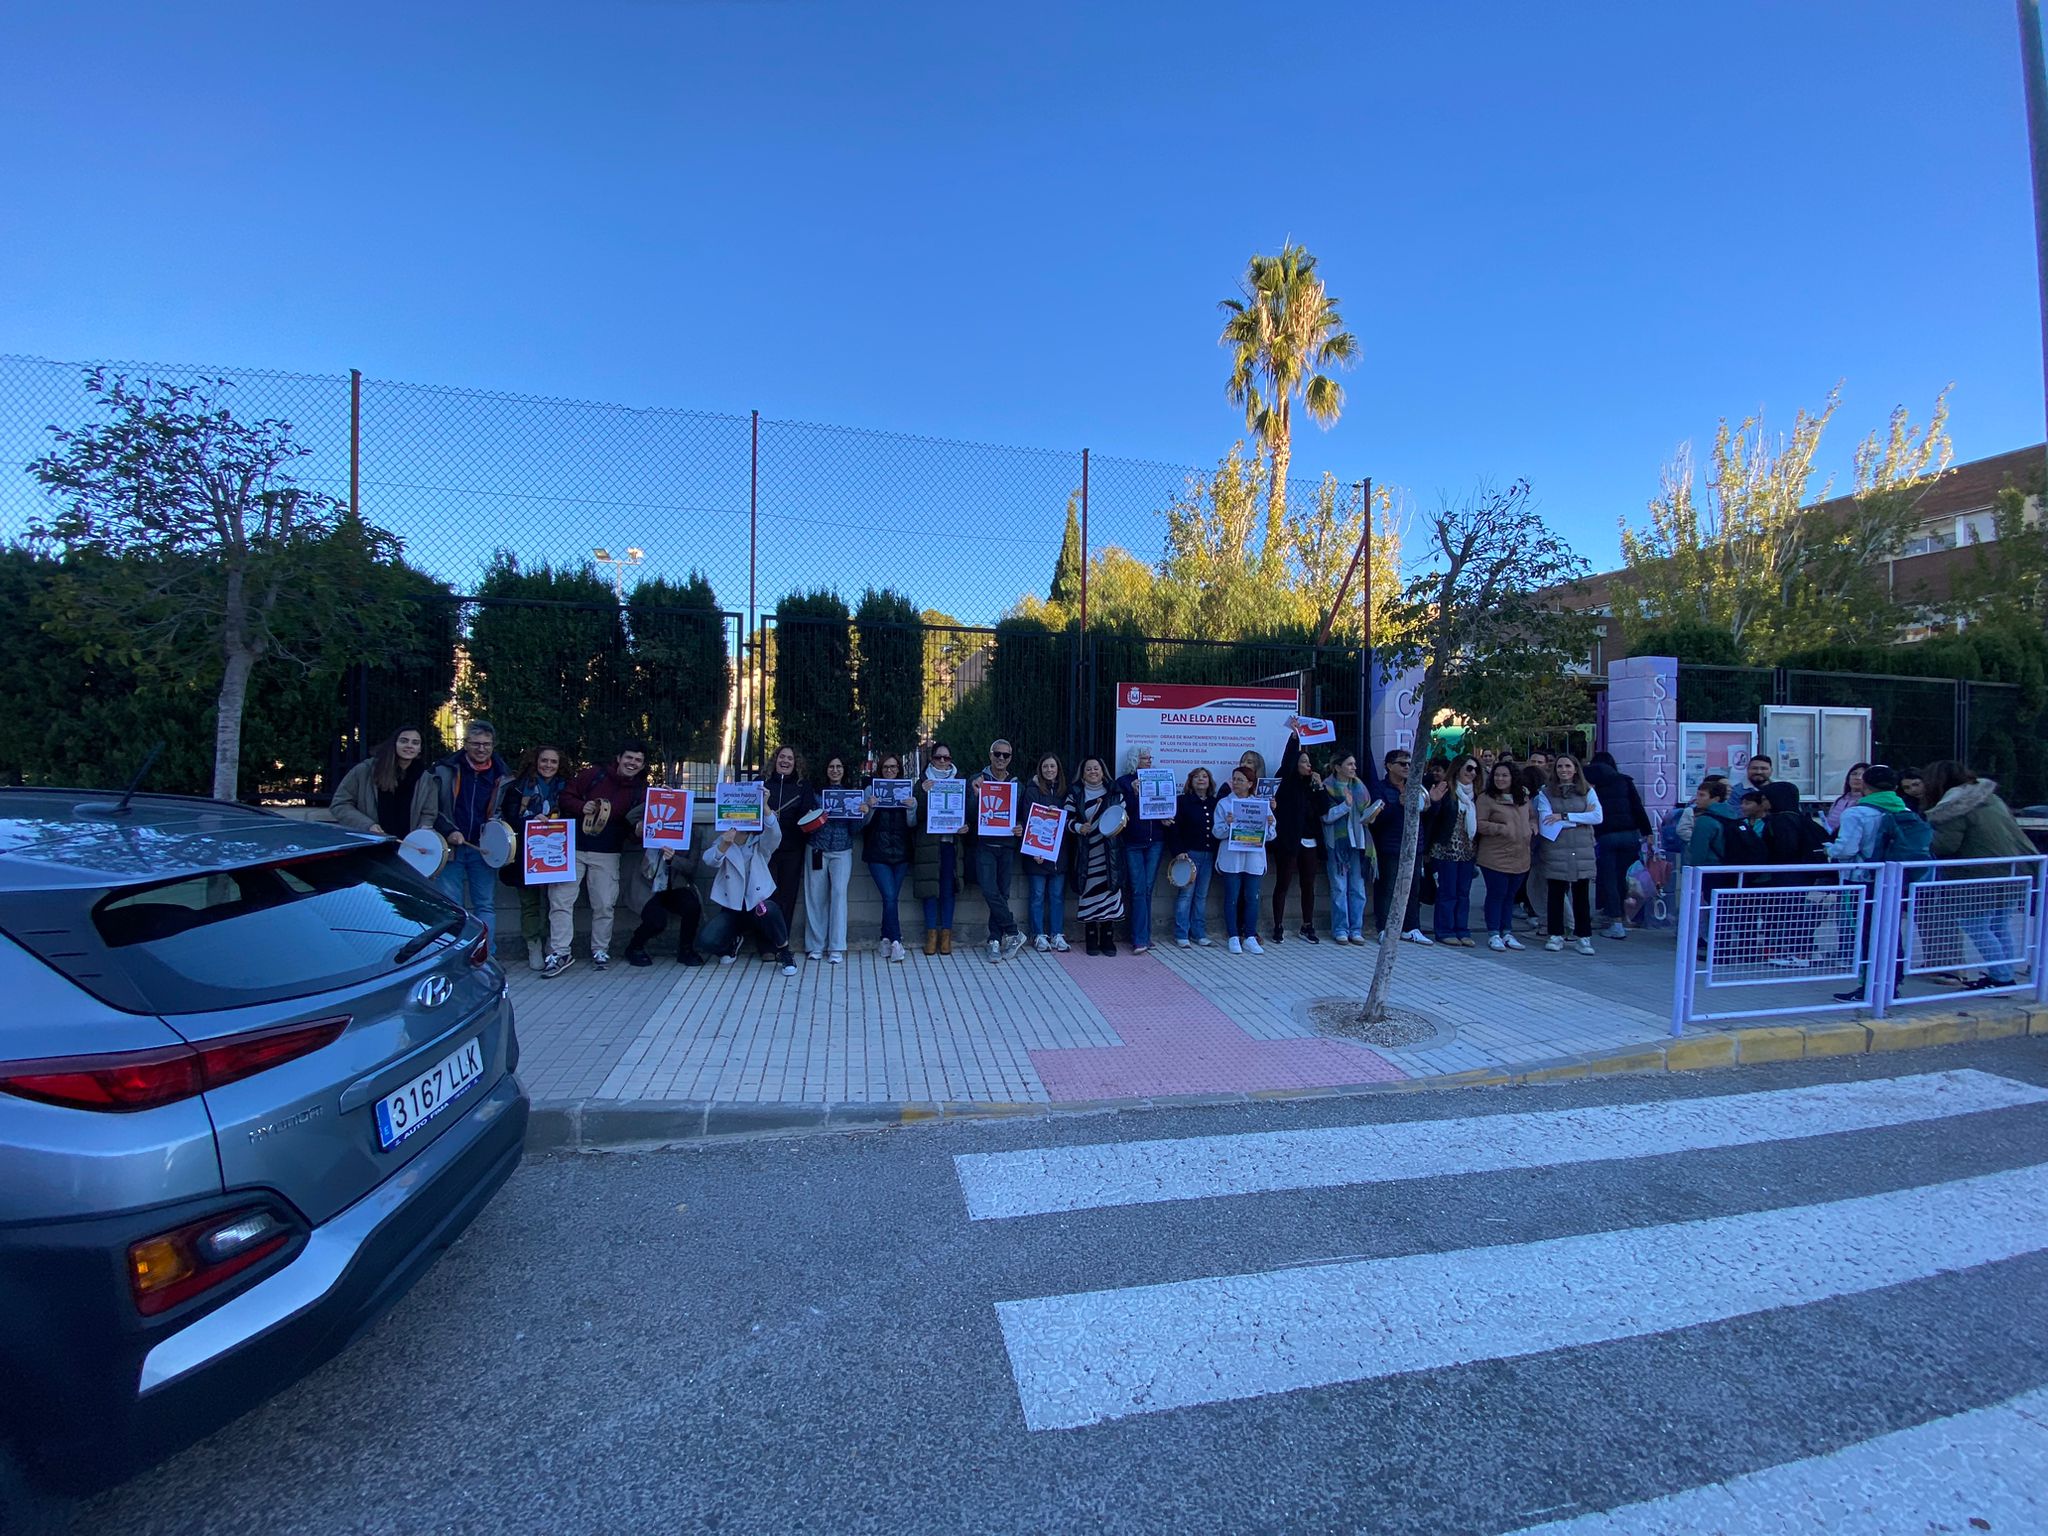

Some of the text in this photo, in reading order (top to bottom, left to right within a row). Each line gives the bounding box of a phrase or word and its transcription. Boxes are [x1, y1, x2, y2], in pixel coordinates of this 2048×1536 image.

[1161, 713, 1256, 724] PLAN ELDA RENACE
[1652, 673, 1668, 799] SANTO
[393, 1044, 479, 1128] 3167 LLK
[404, 1102, 450, 1140] AUTO FIMA
